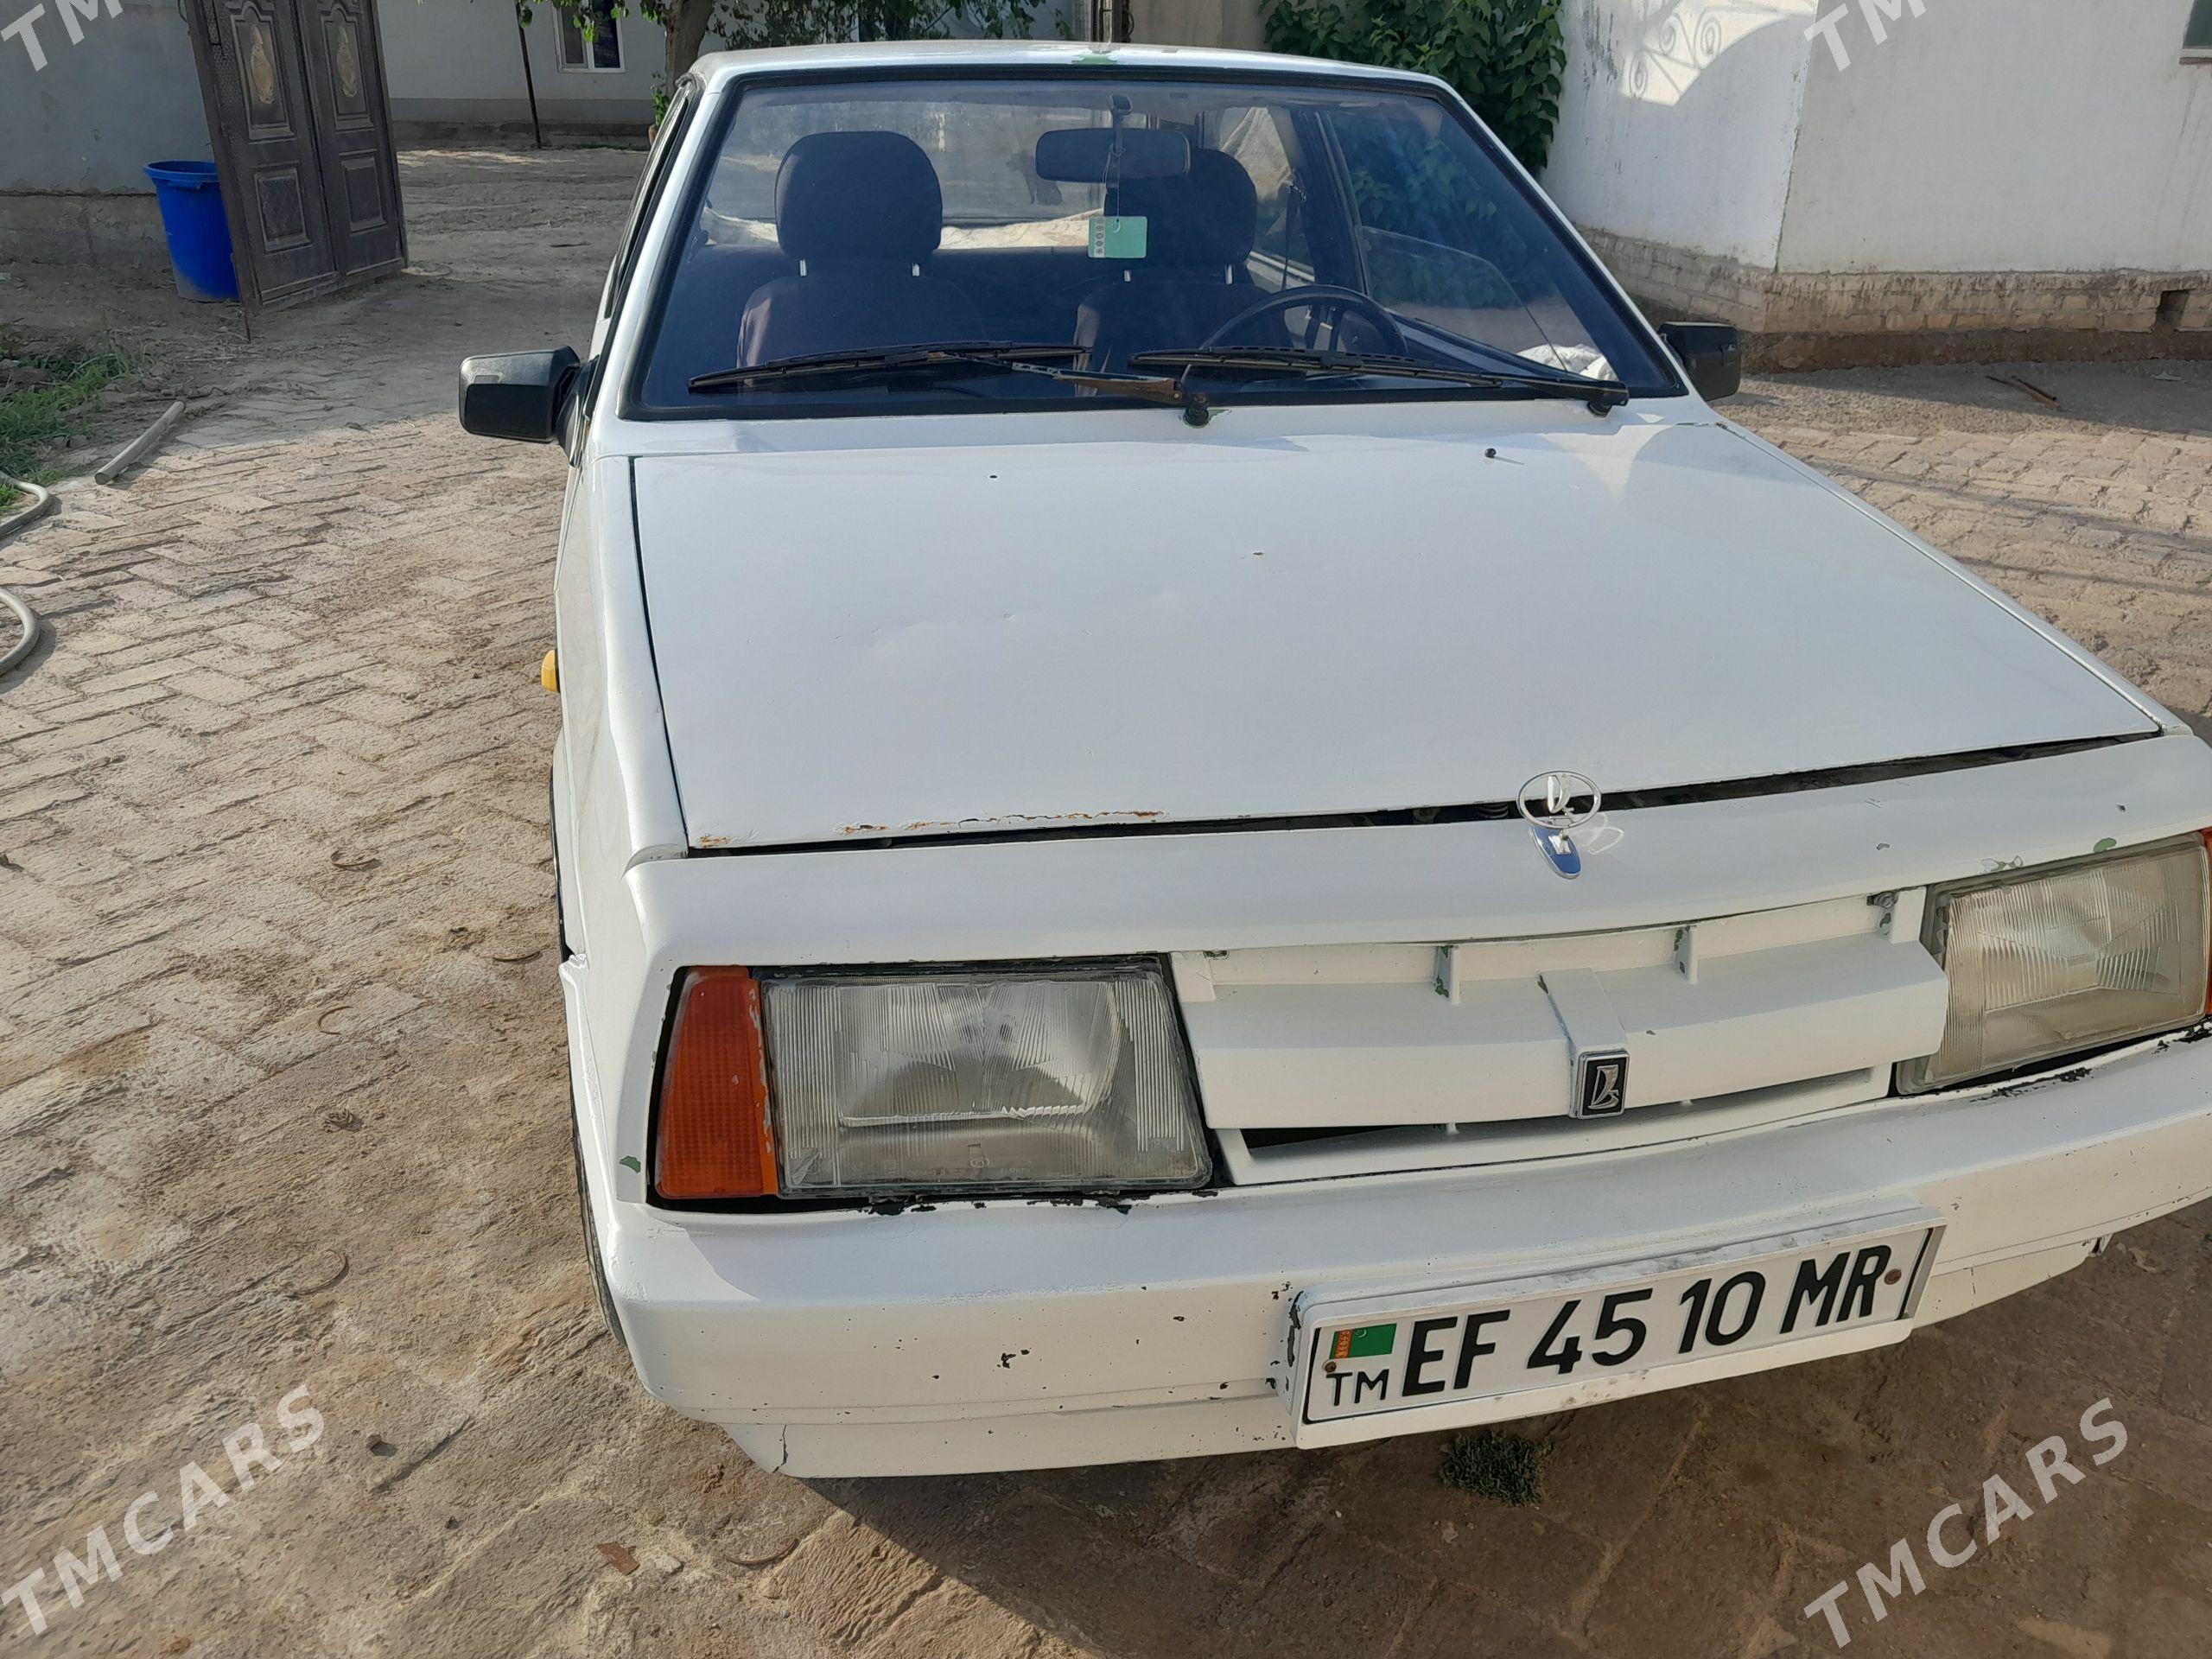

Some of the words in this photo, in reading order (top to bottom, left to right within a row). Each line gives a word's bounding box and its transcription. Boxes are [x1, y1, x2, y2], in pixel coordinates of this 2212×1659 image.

[1402, 1309, 1510, 1397] EF
[1527, 1287, 1653, 1375] 45
[1678, 1271, 1766, 1354] 10
[1779, 1244, 1892, 1334] MR
[1326, 1369, 1390, 1406] TM
